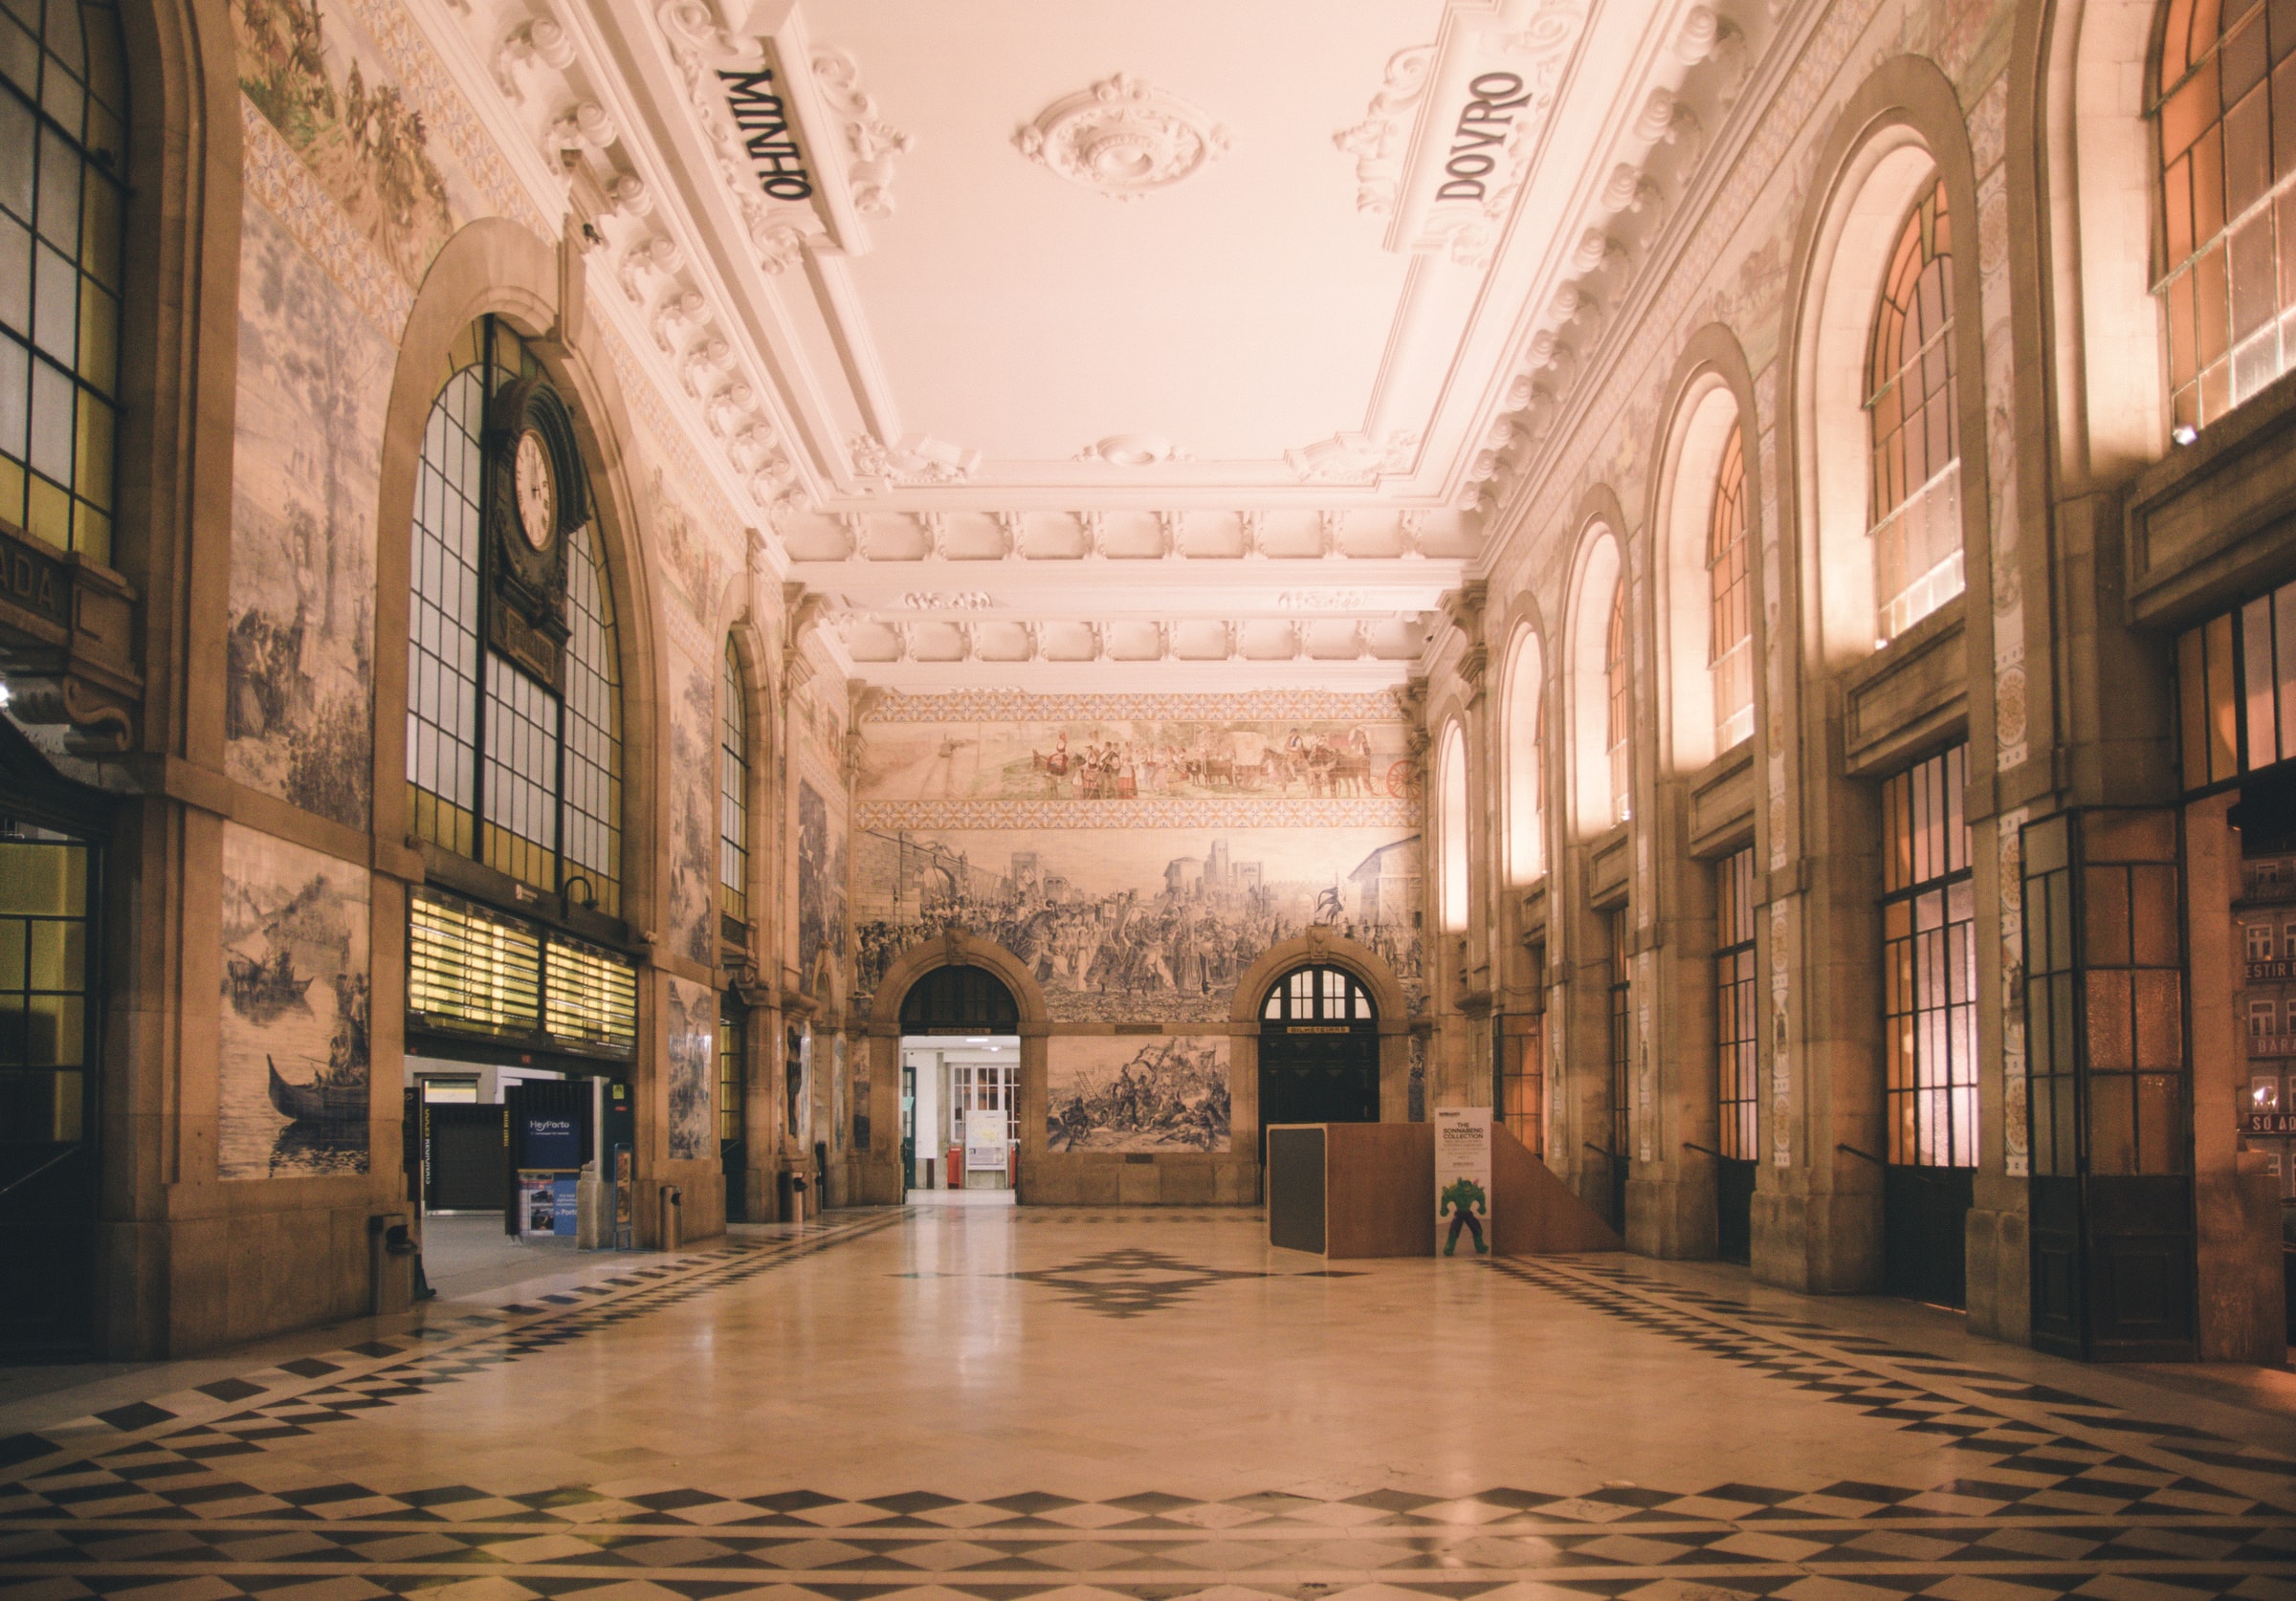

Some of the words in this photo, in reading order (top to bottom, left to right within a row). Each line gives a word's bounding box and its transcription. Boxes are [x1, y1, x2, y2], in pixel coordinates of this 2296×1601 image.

[717, 69, 812, 201] MINHO
[1435, 72, 1533, 203] DOVRO
[530, 1120, 570, 1132] HeyPorto
